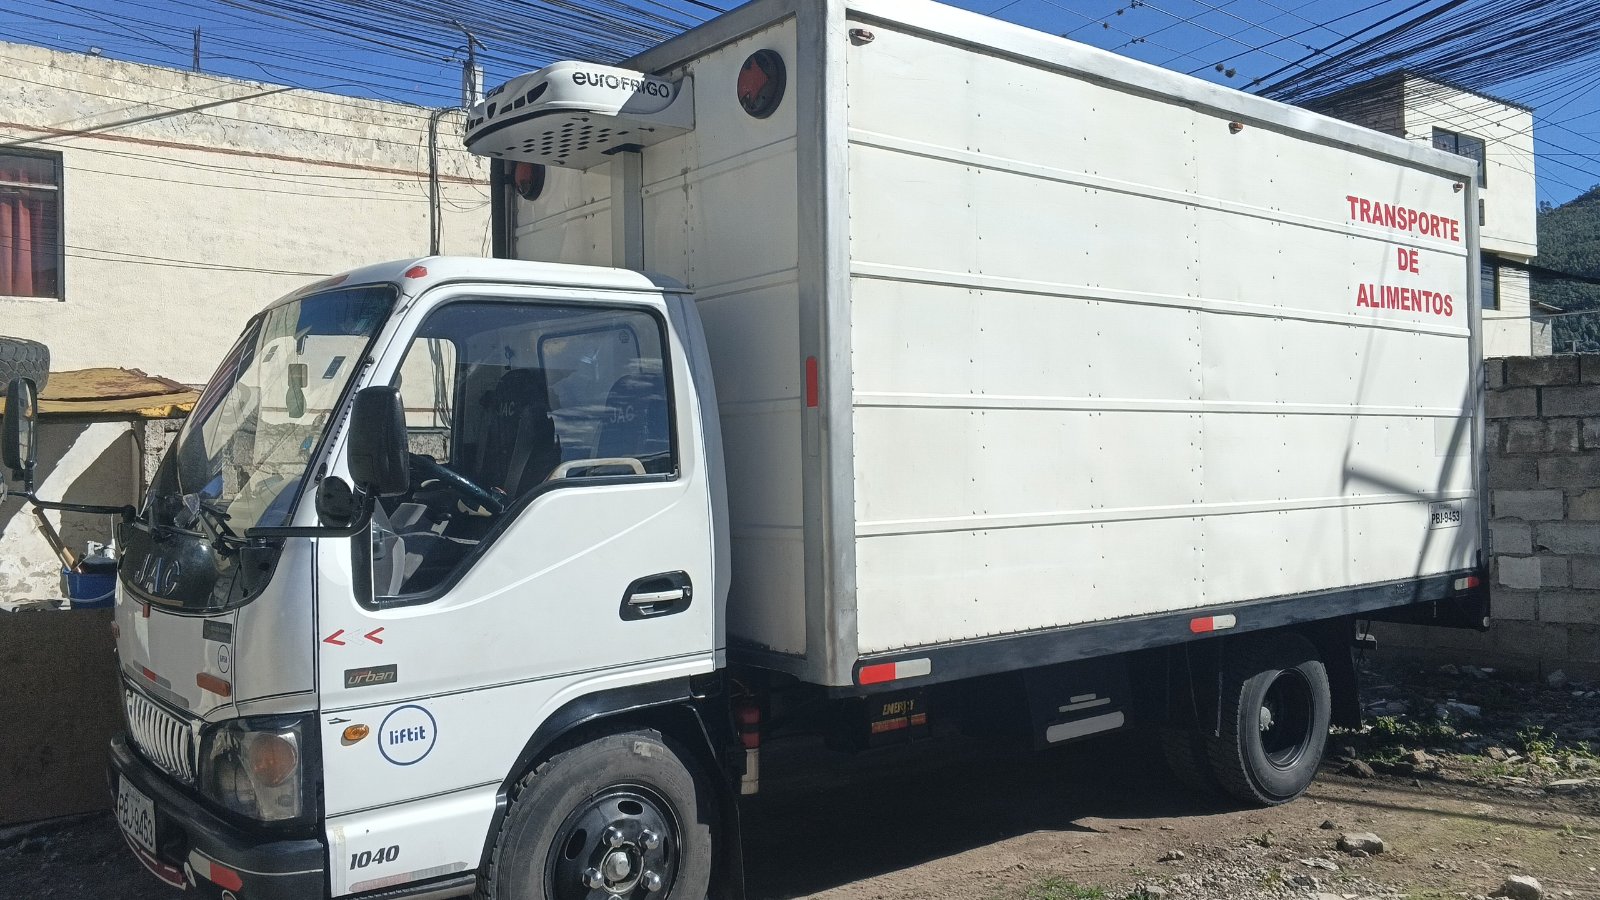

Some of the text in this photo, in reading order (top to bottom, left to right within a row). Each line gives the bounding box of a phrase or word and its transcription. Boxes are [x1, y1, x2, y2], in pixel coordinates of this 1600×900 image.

[1346, 195, 1460, 242] TRANSPORTE
[1397, 247, 1419, 274] DE
[1356, 283, 1454, 317] ALIMENTOS
[1431, 510, 1460, 525] PBJ-9453
[134, 553, 181, 596] JAC
[347, 670, 395, 685] urban
[389, 726, 426, 745] liftit
[349, 844, 400, 871] 1040
